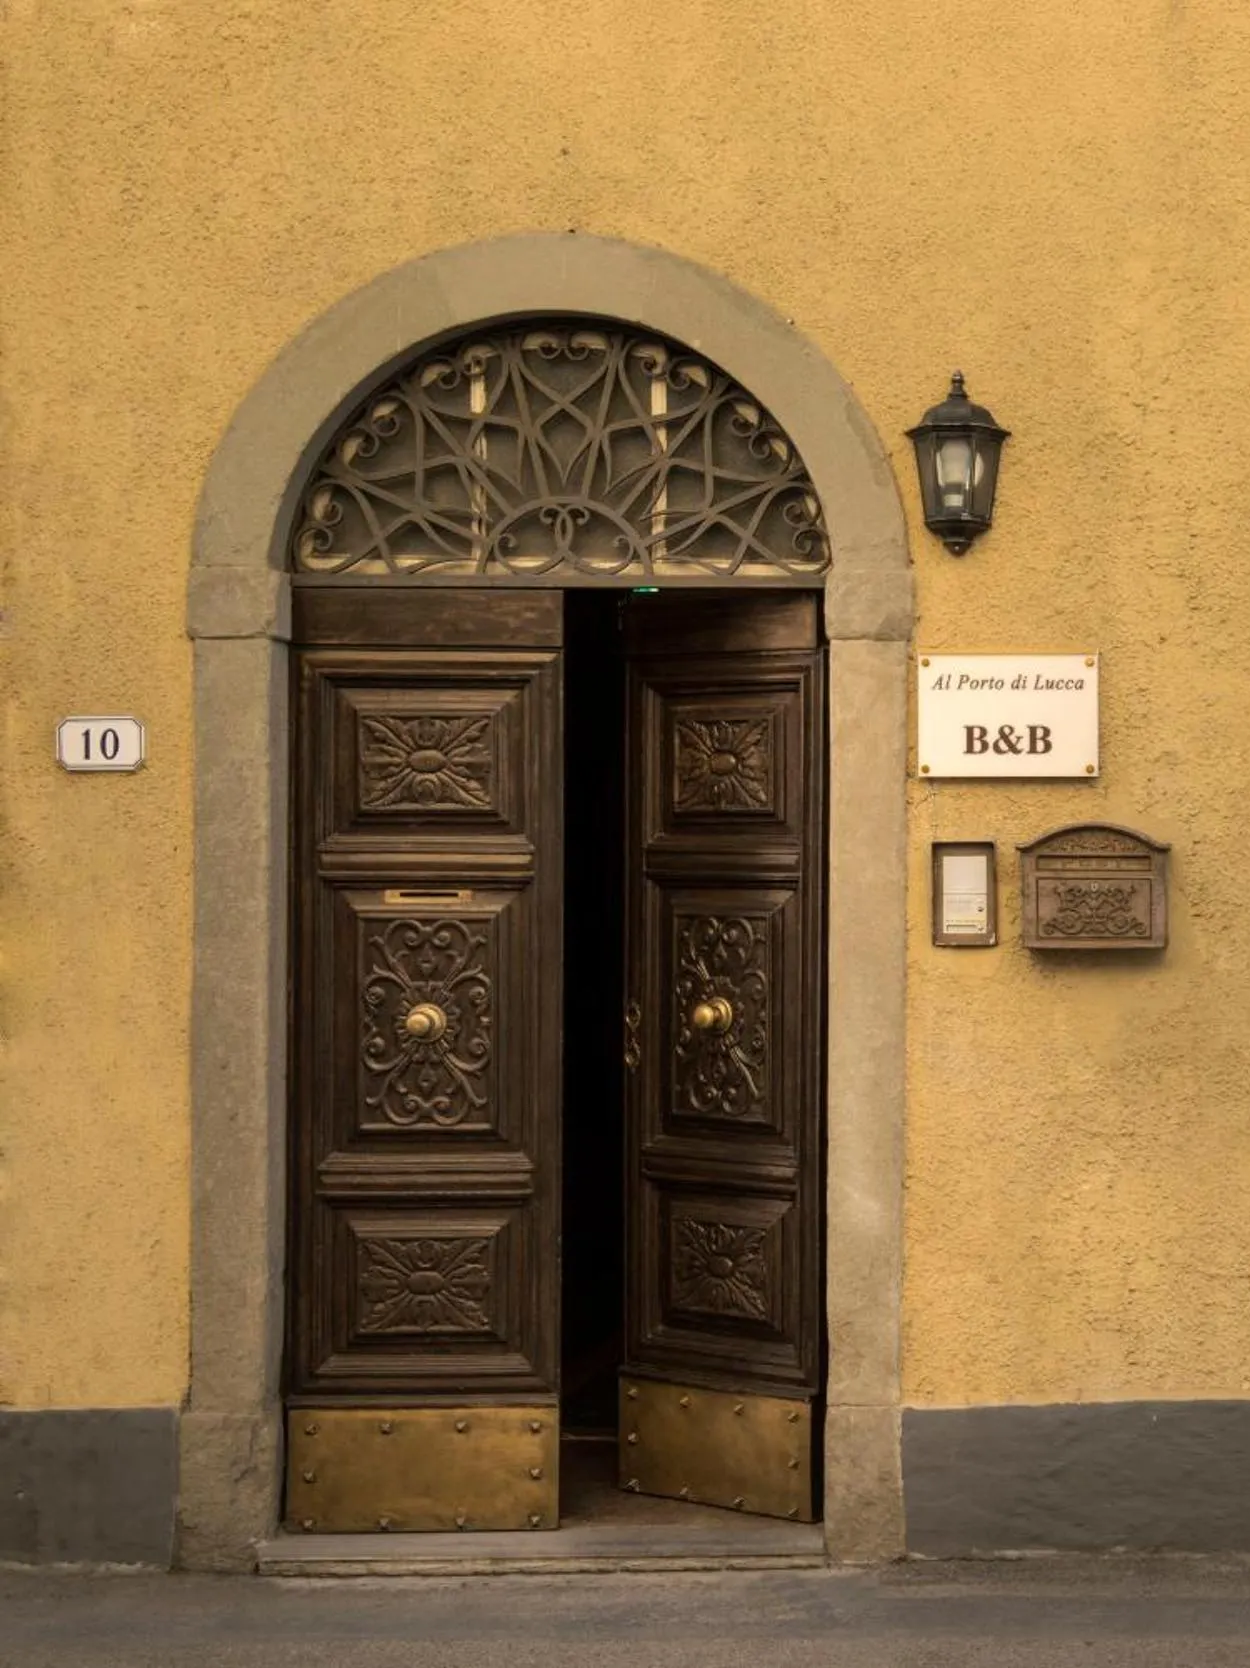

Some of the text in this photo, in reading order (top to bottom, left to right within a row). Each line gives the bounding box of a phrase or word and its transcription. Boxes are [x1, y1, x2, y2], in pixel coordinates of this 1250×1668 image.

[932, 674, 1085, 691] Al Porto di Lucca
[81, 727, 120, 761] 10
[962, 724, 1053, 756] B&B
